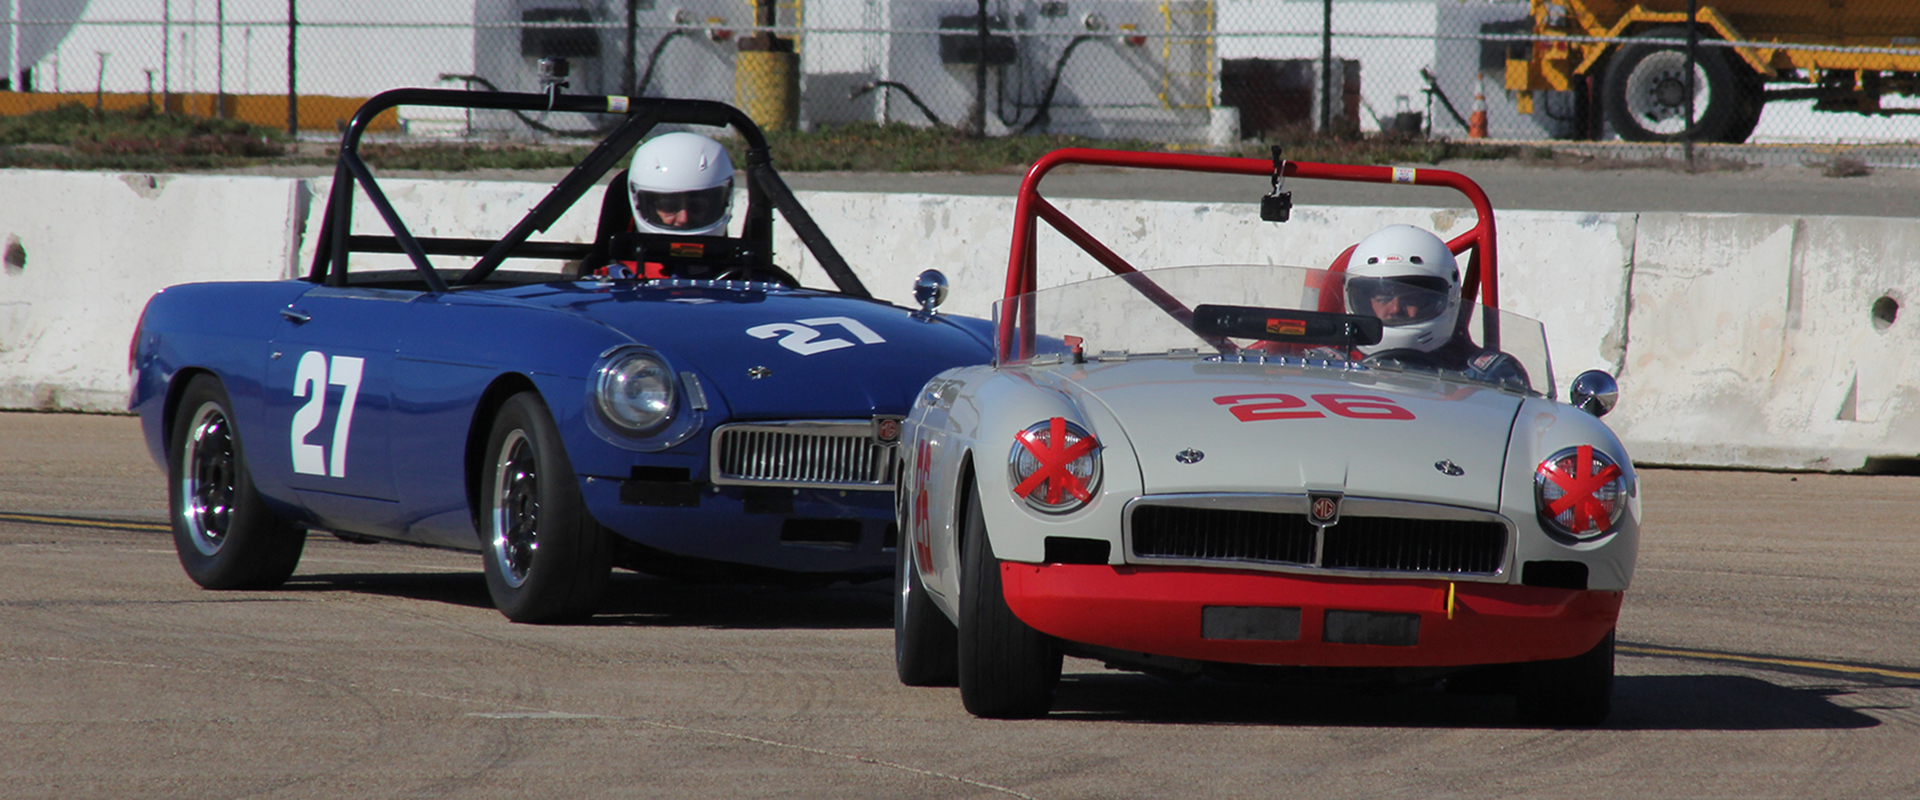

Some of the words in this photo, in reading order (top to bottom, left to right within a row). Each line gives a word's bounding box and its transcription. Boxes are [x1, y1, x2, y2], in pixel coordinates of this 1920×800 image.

[745, 316, 887, 356] 27
[291, 350, 365, 478] 27
[1212, 393, 1416, 422] 26
[880, 421, 898, 438] MG
[915, 438, 935, 576] 26
[1314, 499, 1335, 518] MG
